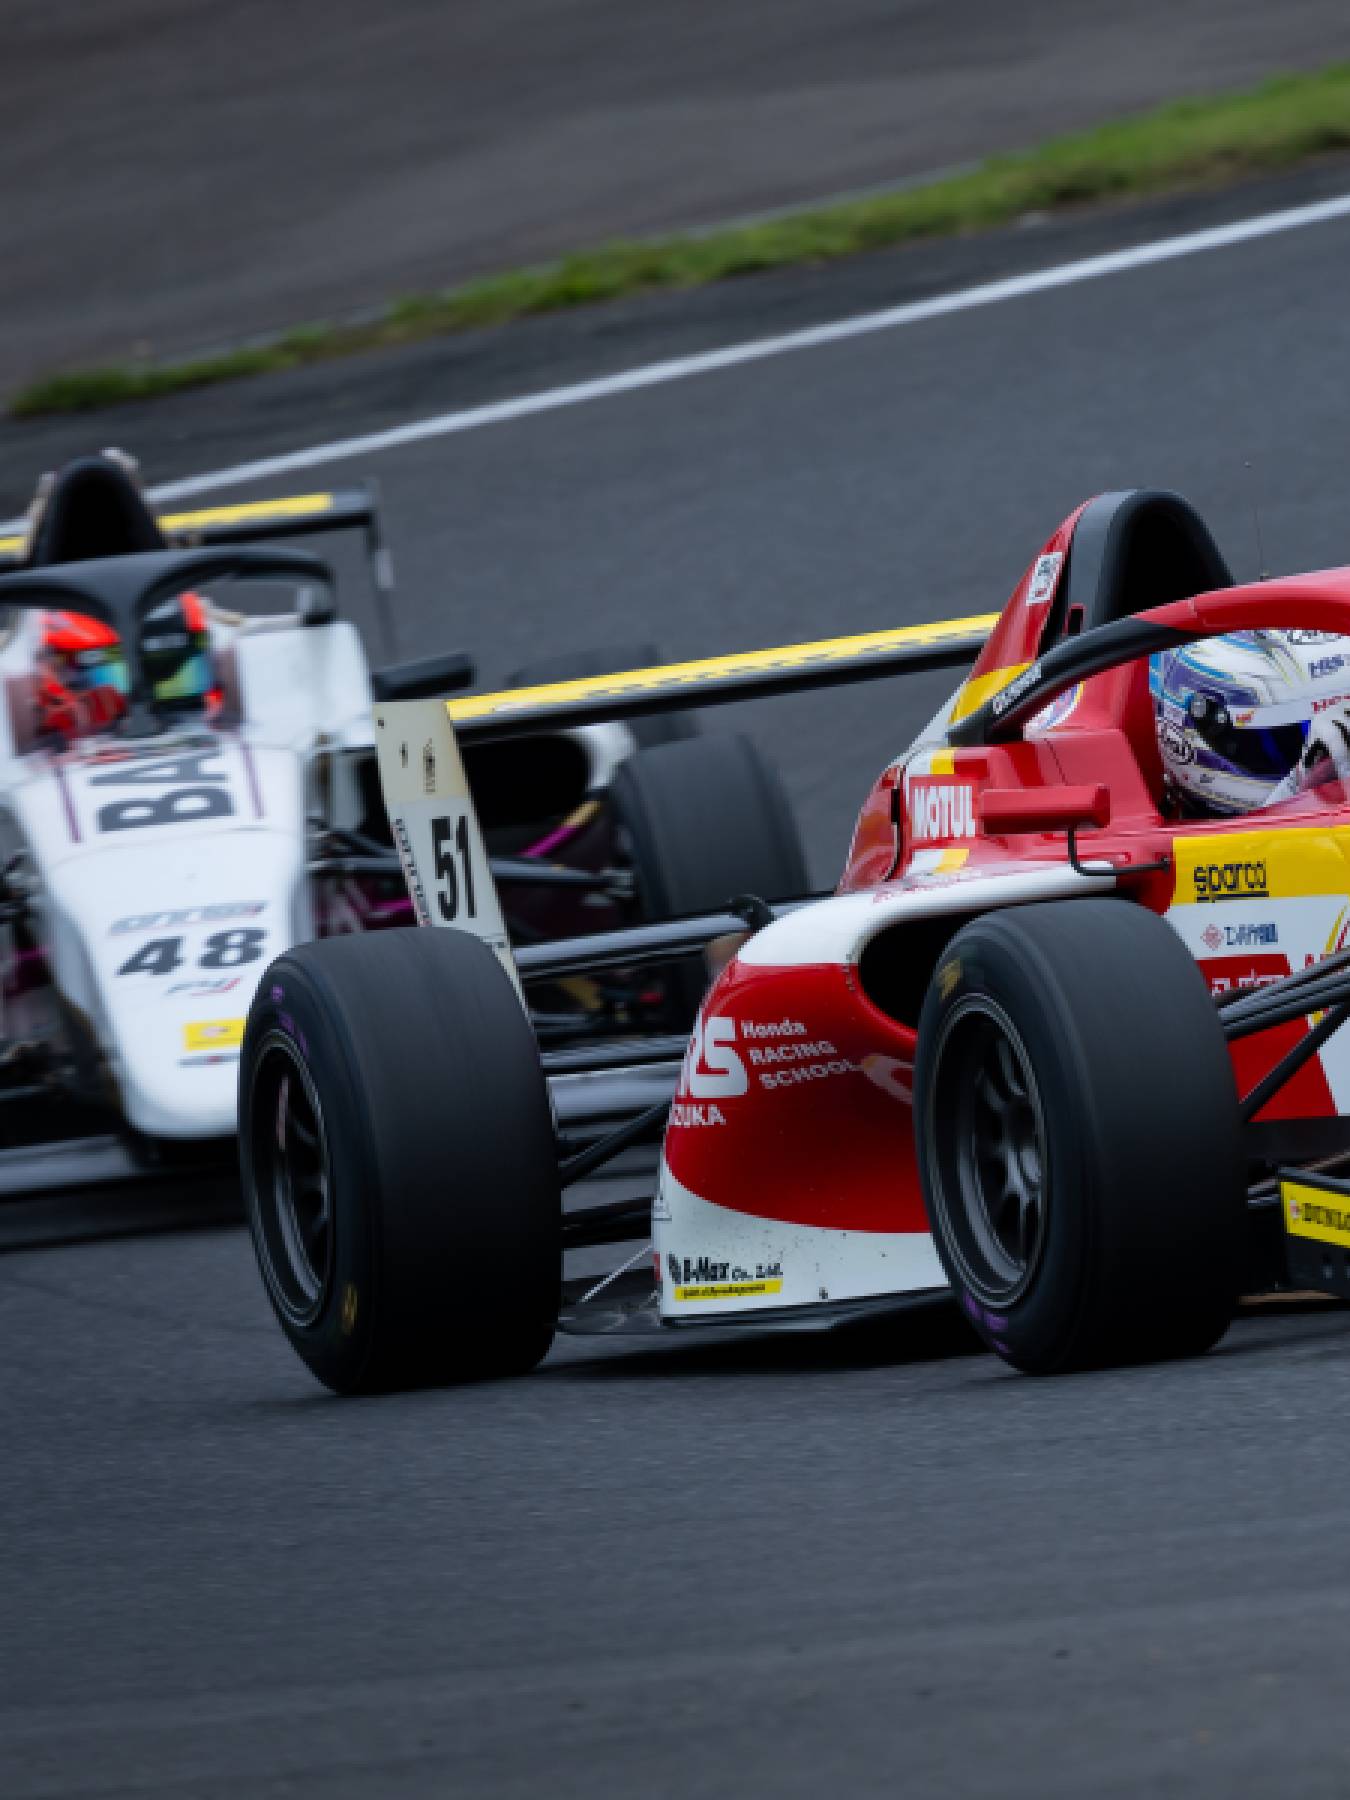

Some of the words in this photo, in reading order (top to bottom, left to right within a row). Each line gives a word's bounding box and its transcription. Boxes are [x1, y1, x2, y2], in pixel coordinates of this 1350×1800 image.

[912, 784, 976, 838] MOTUL
[430, 815, 478, 922] 51
[1193, 862, 1268, 897] sparco
[115, 927, 268, 977] 48
[740, 1017, 808, 1039] Honda
[748, 1040, 838, 1067] RACING
[758, 1059, 863, 1091] SCHOOL
